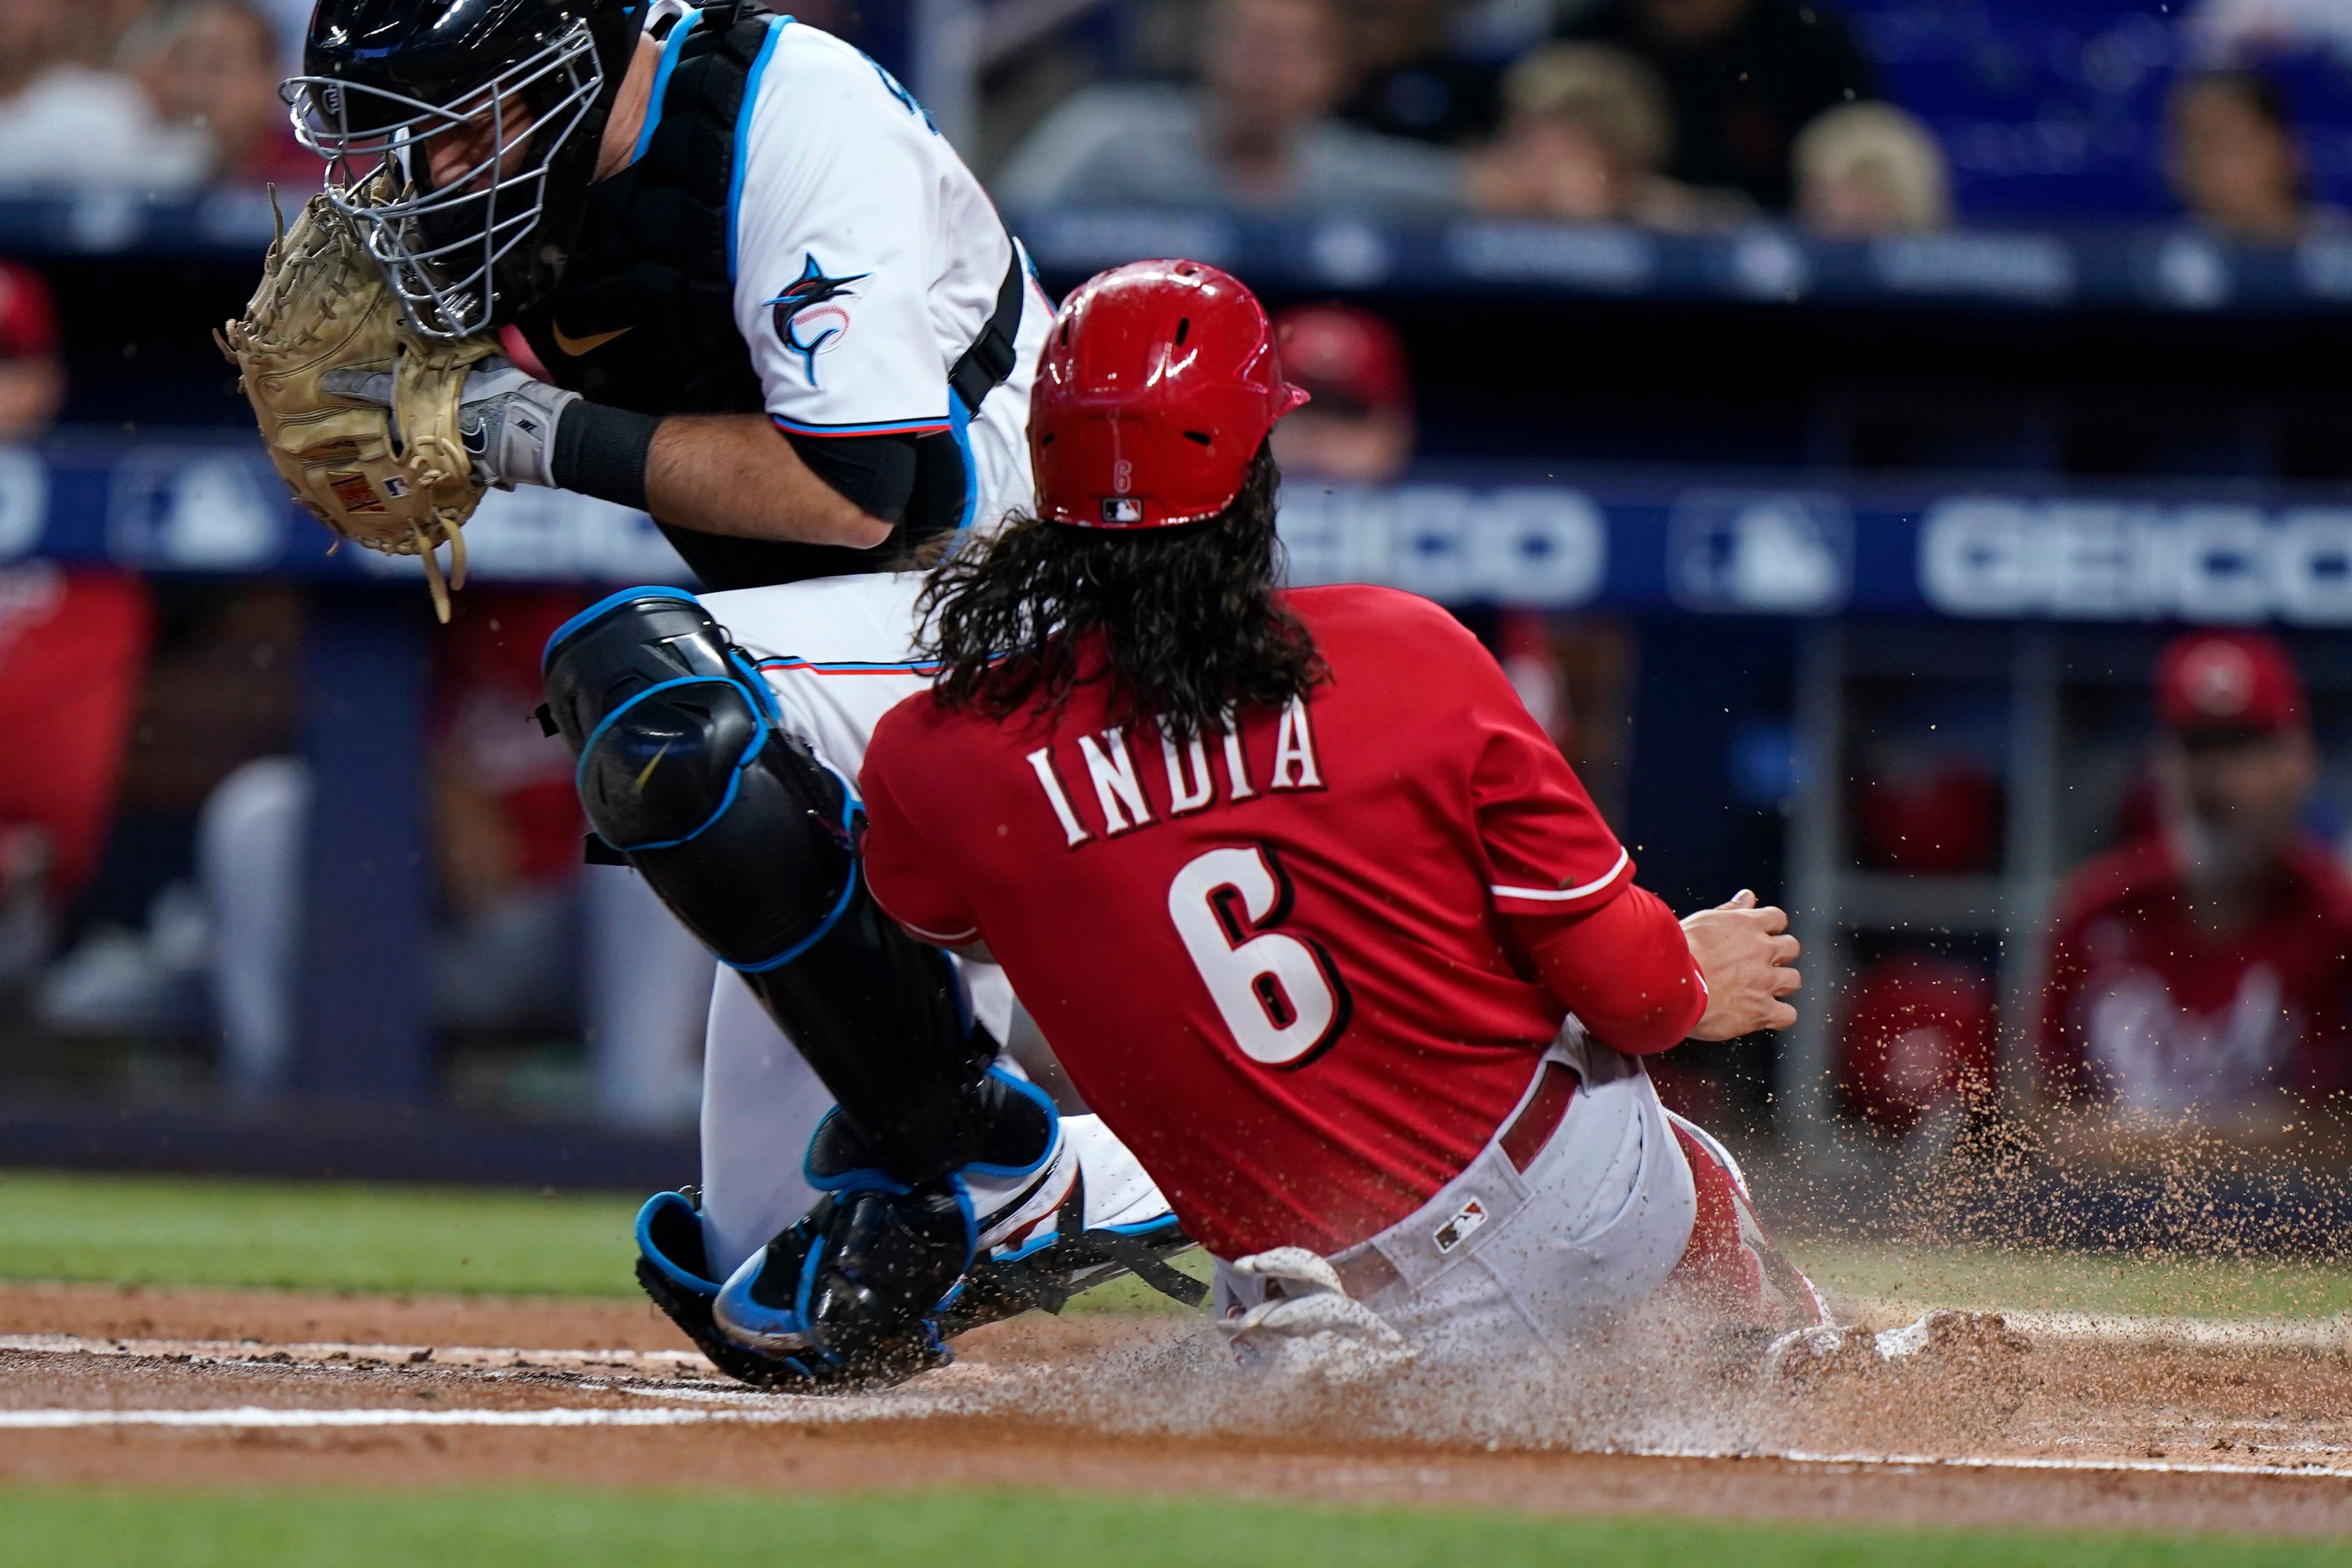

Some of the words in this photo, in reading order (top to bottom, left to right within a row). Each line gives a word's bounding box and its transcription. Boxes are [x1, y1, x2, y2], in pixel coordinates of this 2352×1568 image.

[1113, 459, 1132, 494] 6
[1275, 485, 1607, 608] EICO
[1026, 694, 1327, 849] INDIA
[1168, 844, 1347, 1068] 6
